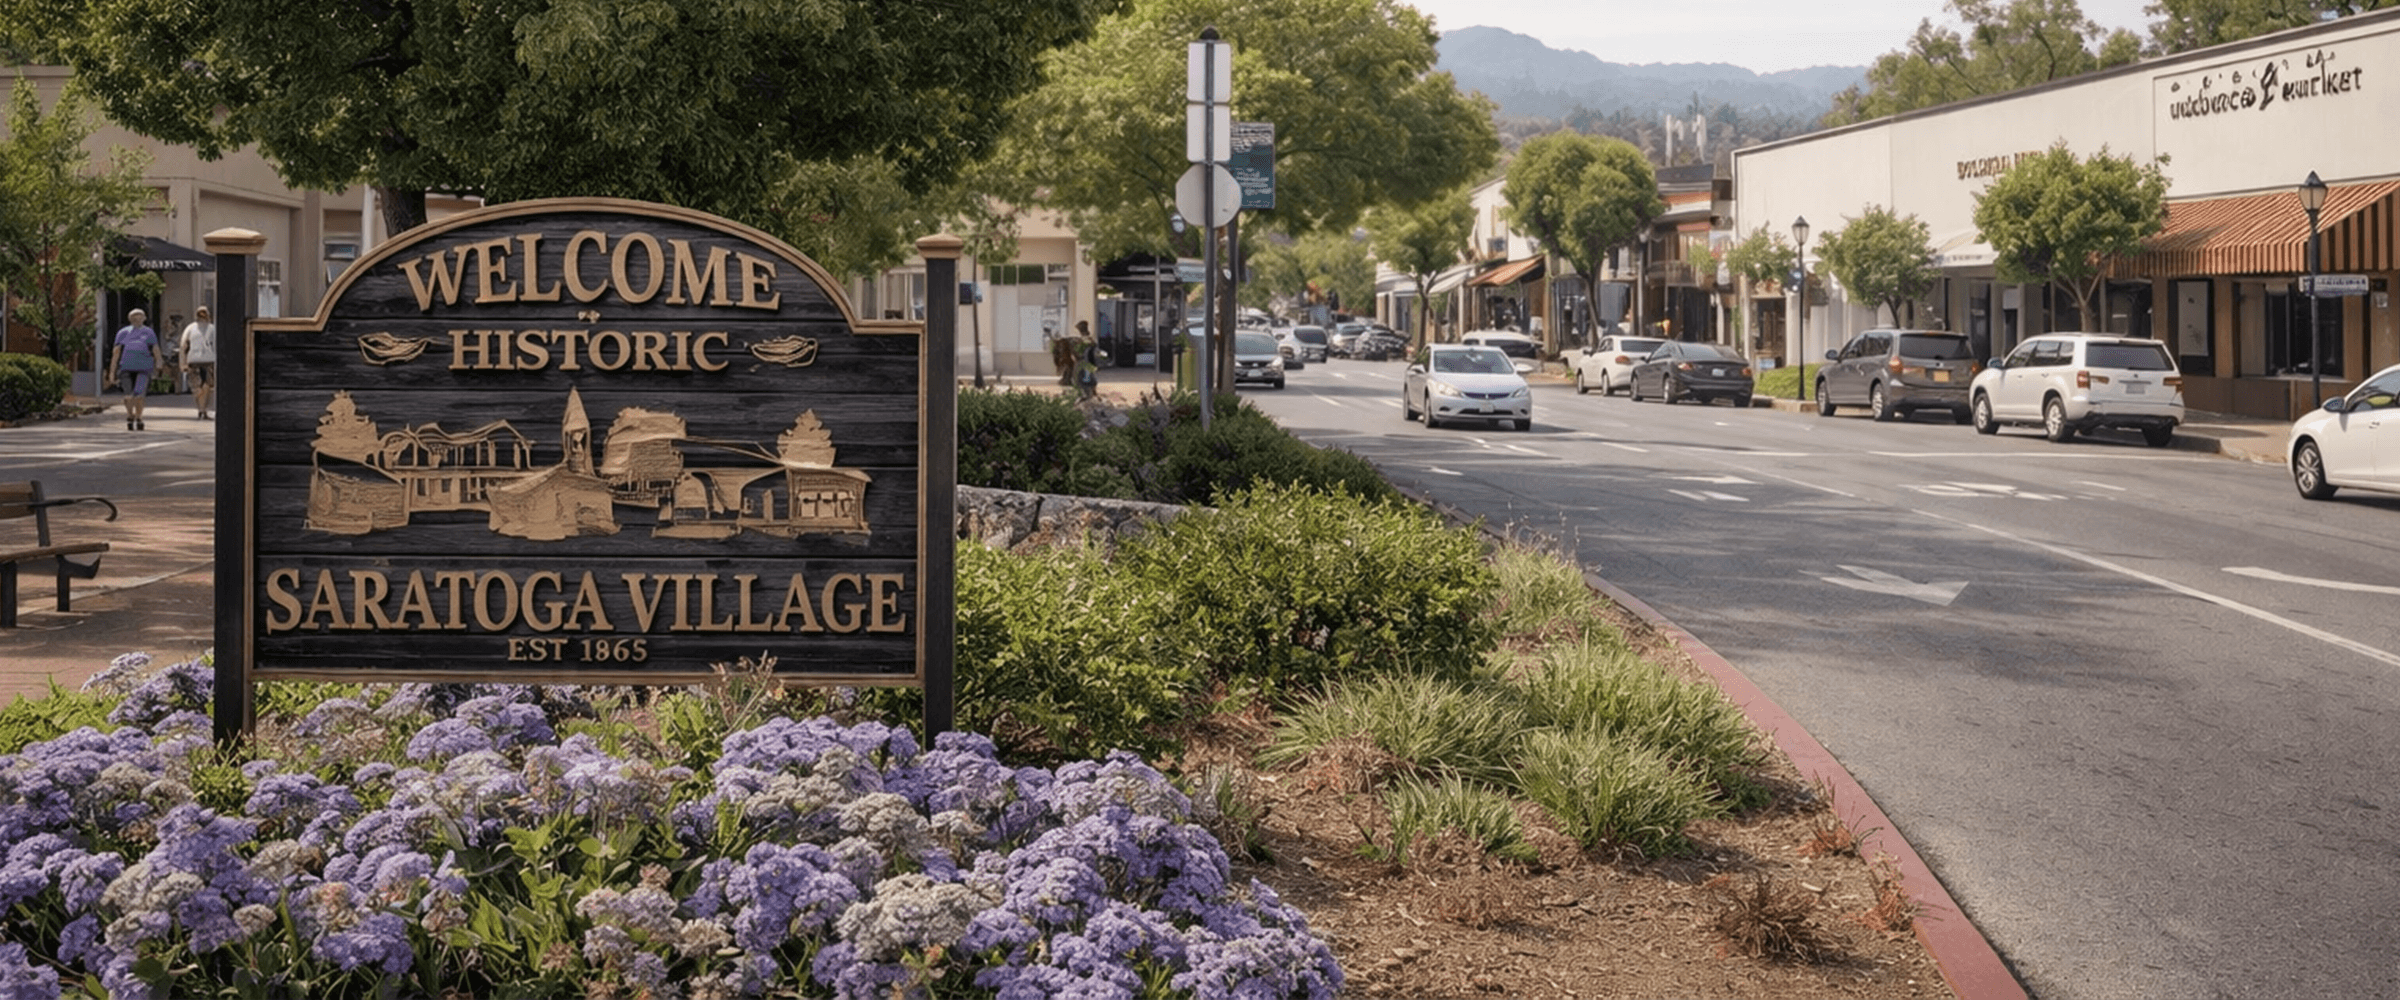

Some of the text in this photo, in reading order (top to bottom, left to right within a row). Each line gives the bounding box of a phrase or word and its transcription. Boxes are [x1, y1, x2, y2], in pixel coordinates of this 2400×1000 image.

[397, 230, 781, 311] WELCOME
[447, 329, 729, 372] HISTORIC
[266, 568, 906, 634] SARATOGA VILLAGE
[507, 638, 648, 662] EST 1865
